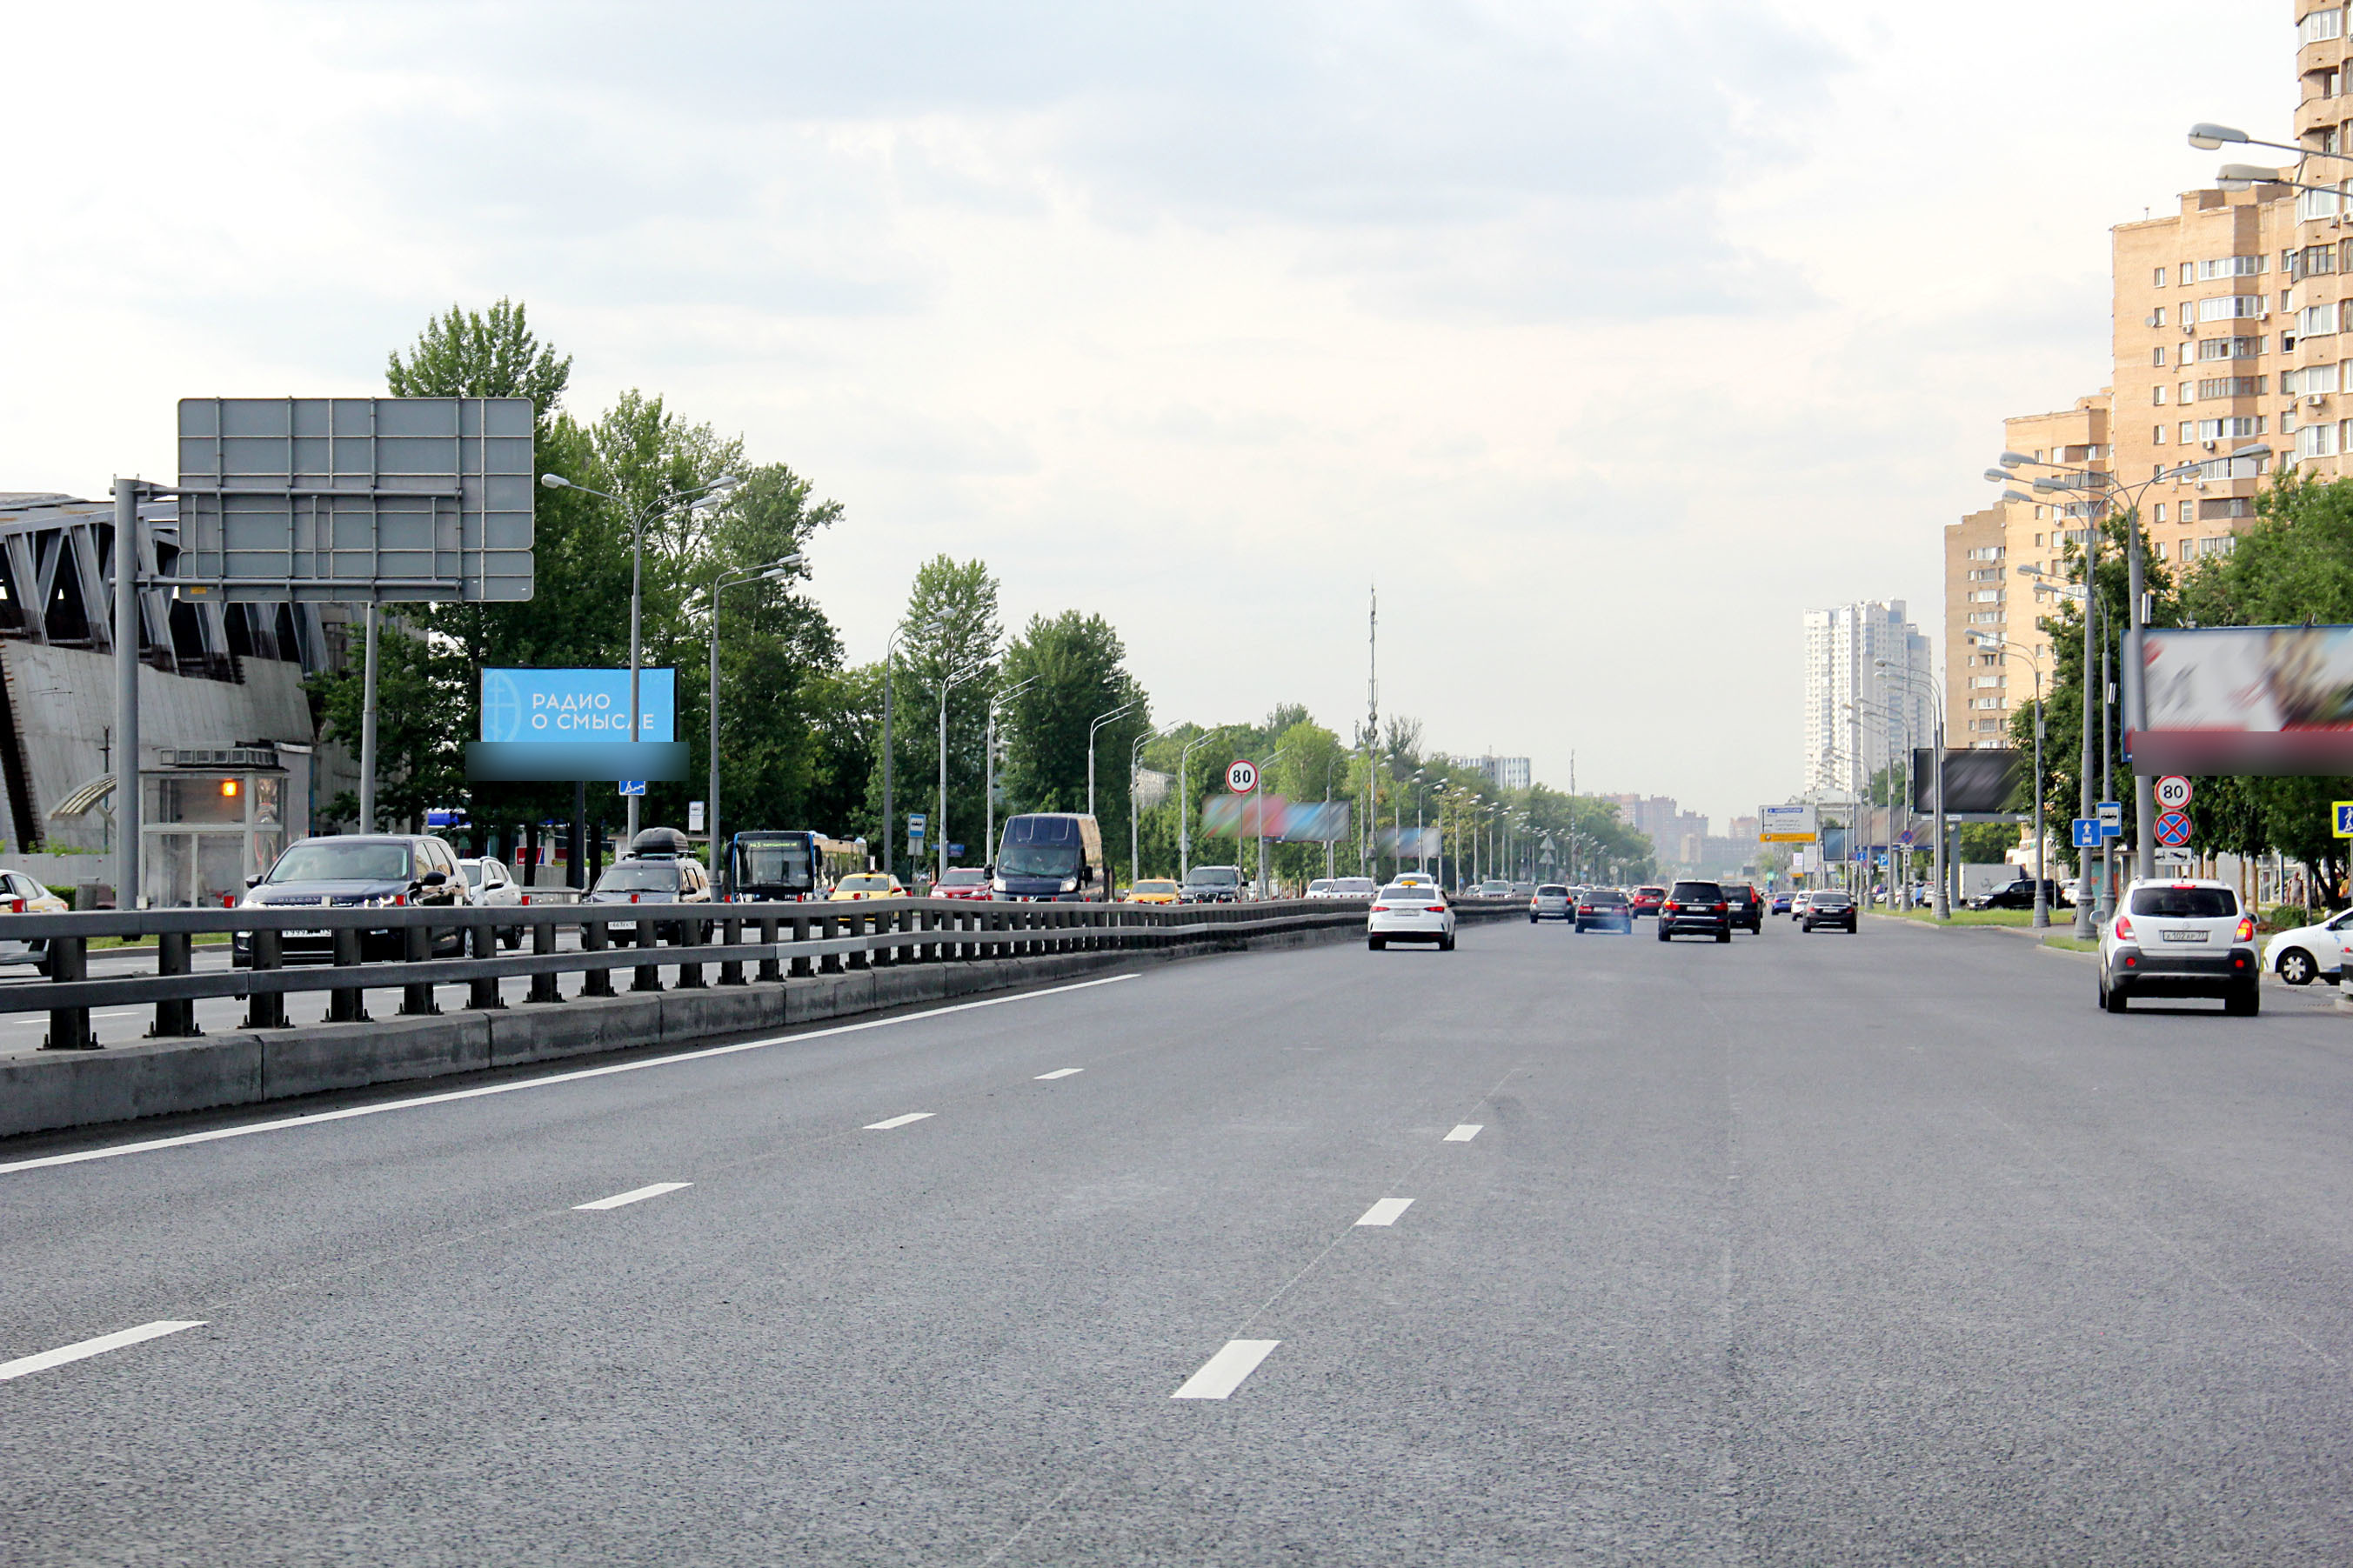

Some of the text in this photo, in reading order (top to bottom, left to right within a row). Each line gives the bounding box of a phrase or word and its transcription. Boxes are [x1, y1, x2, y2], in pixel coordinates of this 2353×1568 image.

[531, 693, 611, 712] РАДИО
[531, 713, 548, 730] О
[1233, 770, 1251, 784] 80
[2163, 784, 2183, 799] 80
